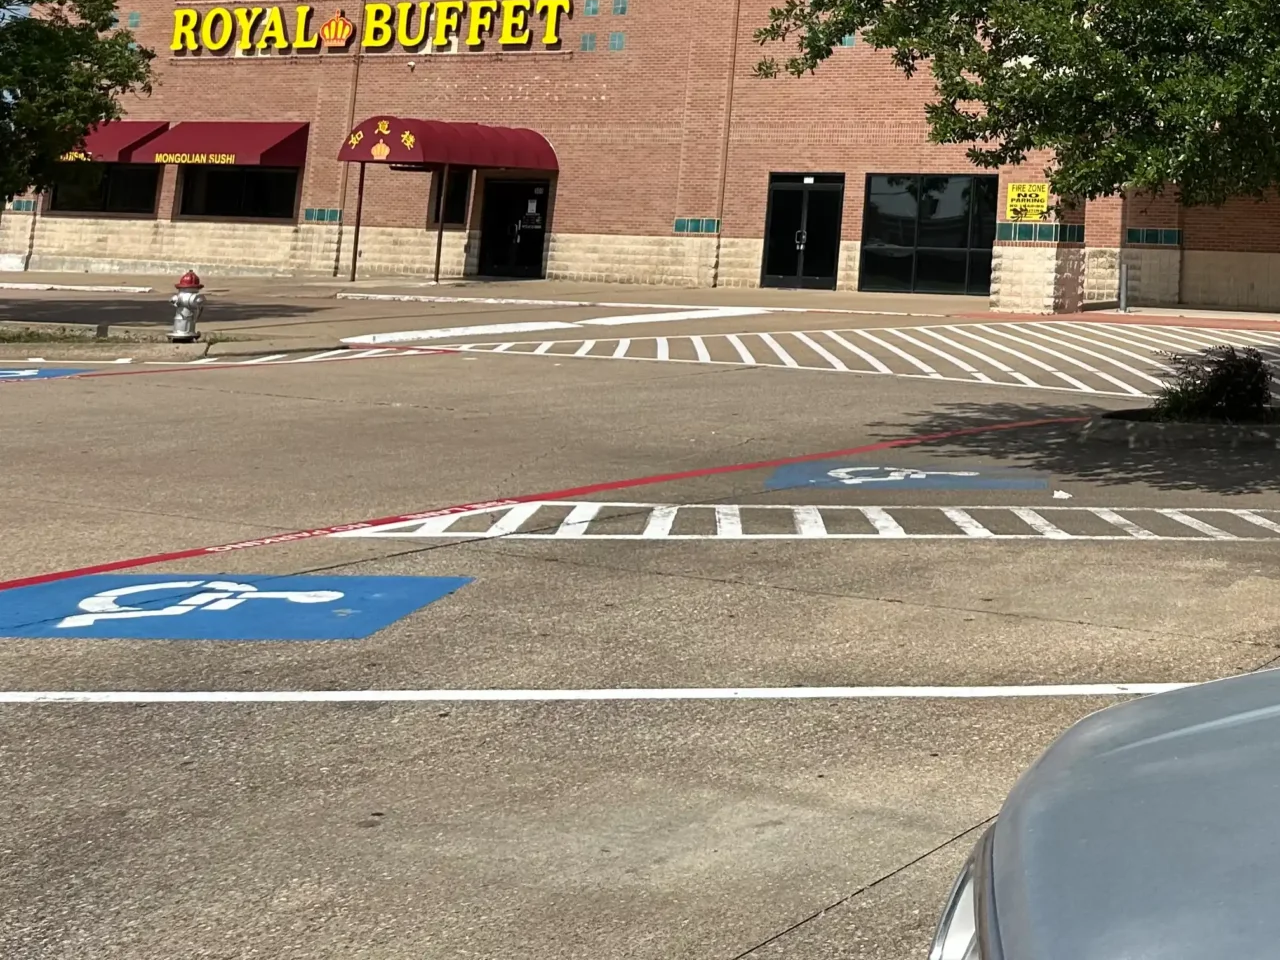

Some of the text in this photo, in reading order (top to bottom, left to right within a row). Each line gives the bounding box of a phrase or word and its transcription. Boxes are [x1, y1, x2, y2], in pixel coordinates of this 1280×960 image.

[170, 5, 319, 51] ROYAL
[155, 153, 236, 164] MONGOLIAN SUSHI
[1012, 184, 1046, 192] FIRE ZONE
